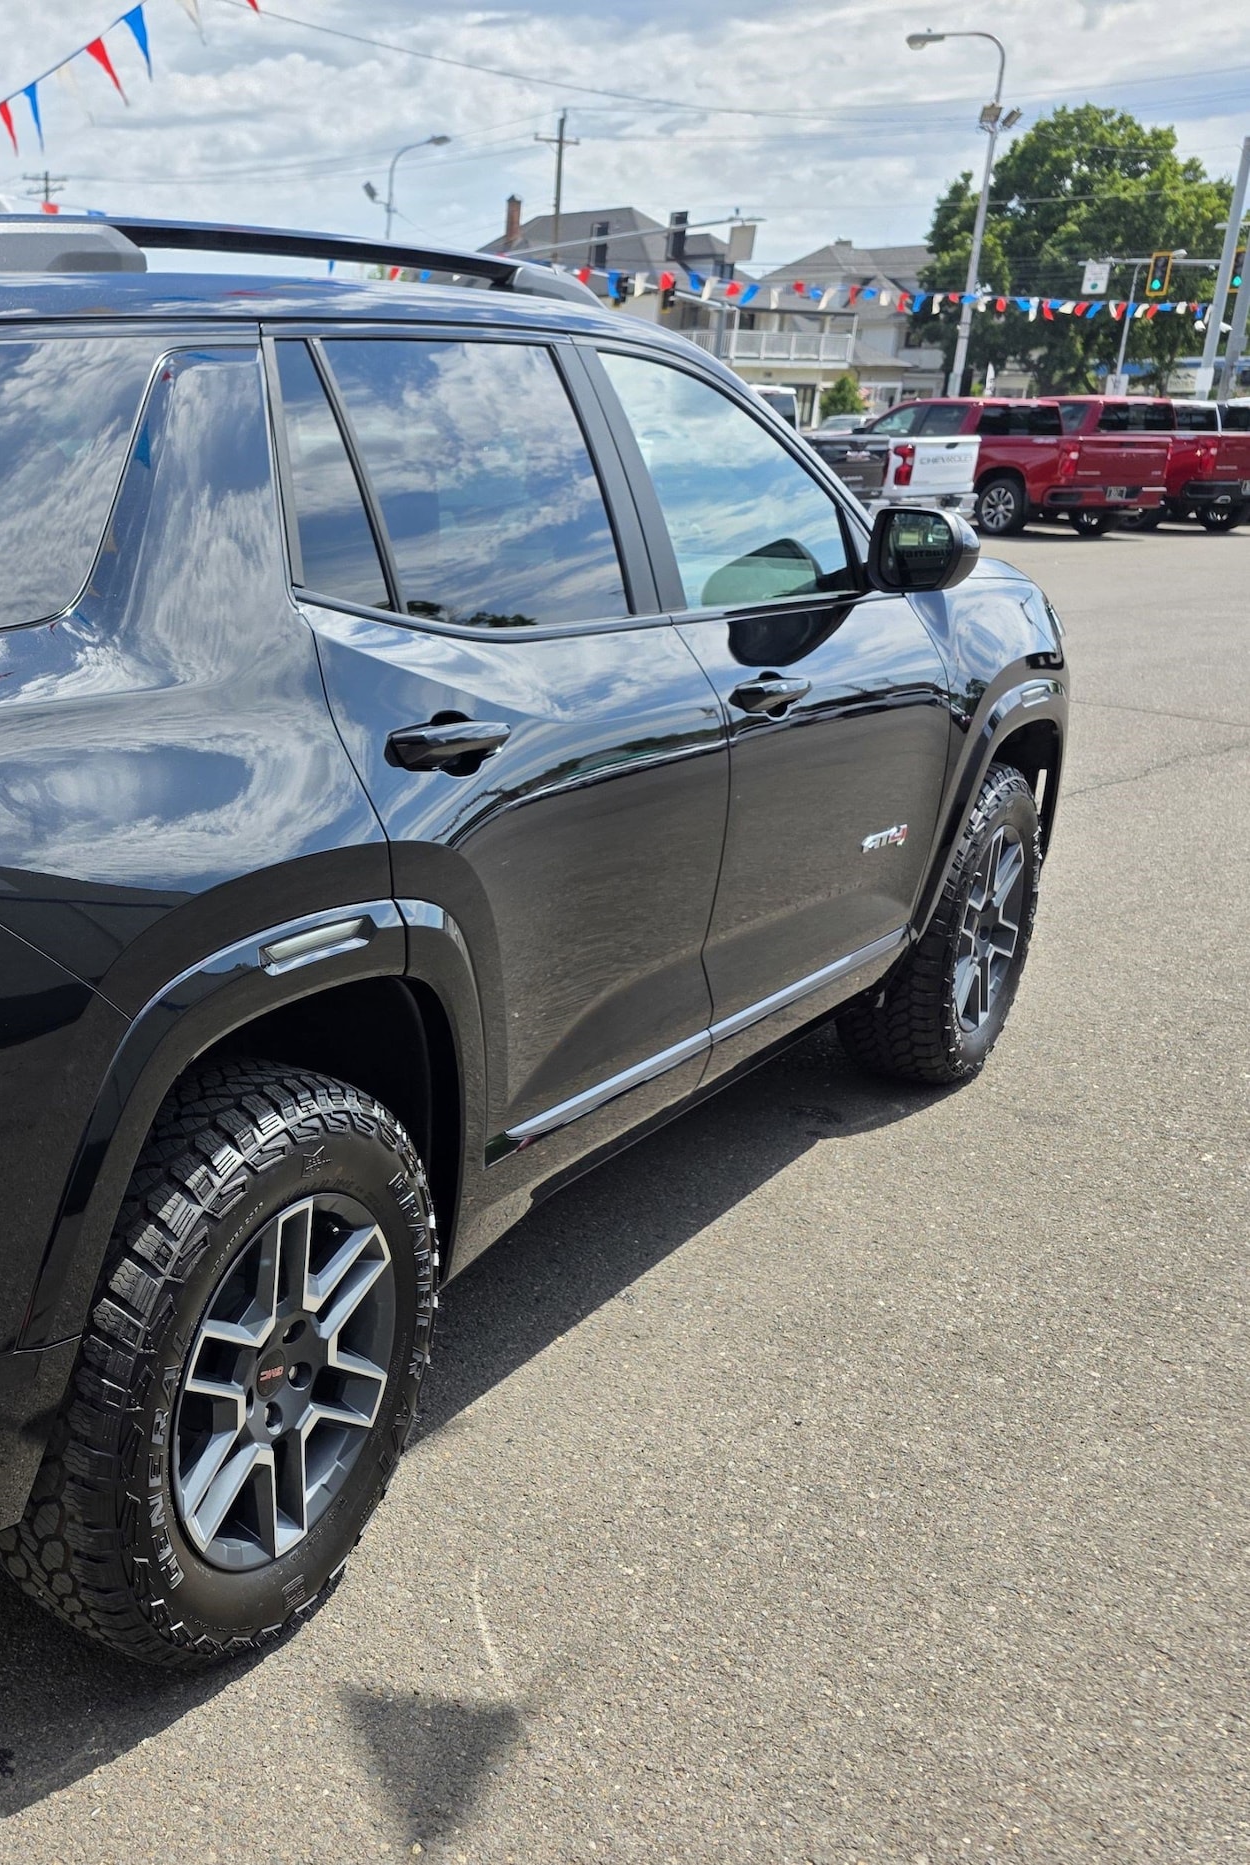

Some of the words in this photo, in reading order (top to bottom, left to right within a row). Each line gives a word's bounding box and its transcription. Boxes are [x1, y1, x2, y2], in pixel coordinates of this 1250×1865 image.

[919, 456, 973, 465] CHEVROLET
[861, 824, 908, 854] AT4
[259, 1365, 284, 1382] GMC
[147, 1322, 193, 1589] GENERAL
